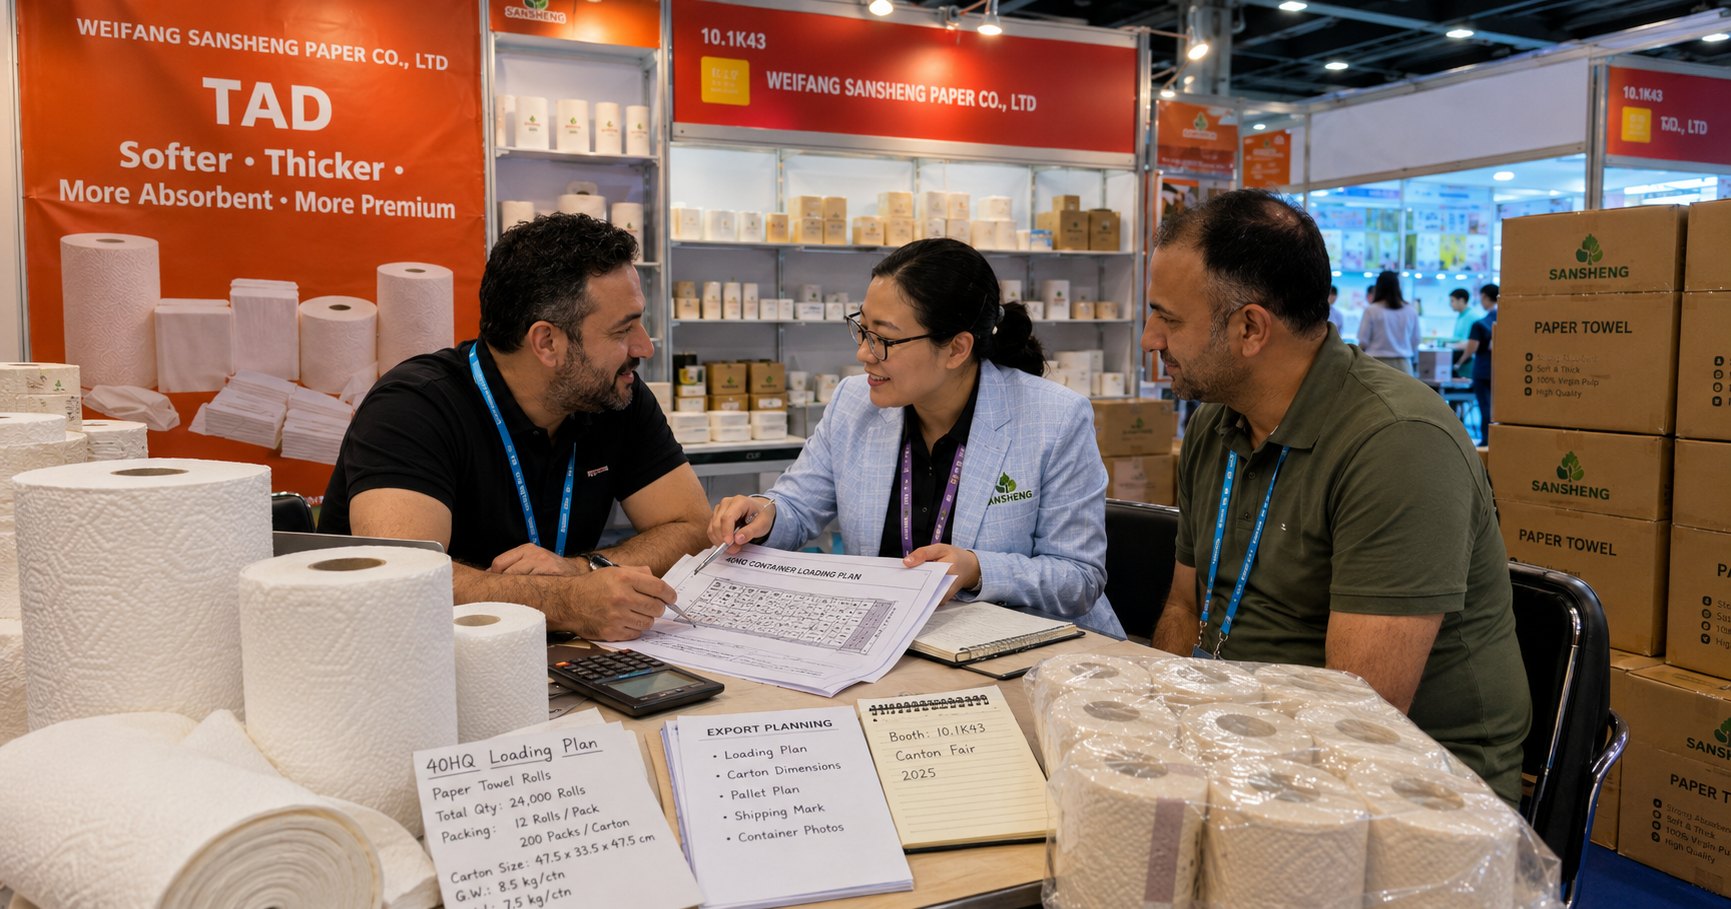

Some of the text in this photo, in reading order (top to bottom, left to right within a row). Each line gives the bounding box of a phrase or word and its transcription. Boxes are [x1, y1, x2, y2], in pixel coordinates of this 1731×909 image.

[506, 7, 565, 22] SANSHENG
[77, 18, 449, 71] WEIFANG SANSHENG PAPER CO., LTD
[701, 27, 766, 49] 10.1K43
[766, 70, 1037, 112] WEIFANG SANSHENG PAPER CO., LTD
[1623, 85, 1663, 102] 10.1K43
[202, 77, 332, 131] TAD
[1688, 119, 1708, 135] LTD
[119, 141, 384, 181] Softer Thicker
[59, 179, 456, 219] More Absorbent More Premium
[1549, 266, 1629, 280] SANSHENG
[1534, 321, 1632, 334] PAPER TOWEL
[988, 490, 1033, 506] ANSHENG
[1531, 480, 1610, 500] SANSHENG
[1519, 529, 1617, 556] PAPER TOWEL
[749, 560, 796, 574] CONTAINER
[797, 568, 837, 578] LOADING
[837, 571, 862, 581] PLAN
[707, 719, 833, 737] EXPORT PLANNING
[889, 722, 986, 743] Booth: 10.1K43
[426, 737, 598, 774] 40HQ Loading Plan
[724, 744, 808, 761] Loading Plan
[895, 744, 976, 762] Canton Fair
[727, 761, 841, 780] Carton Dimensions
[902, 768, 937, 781] 2025
[433, 770, 551, 800] Paper Towel Rolls
[730, 784, 800, 800] Pallet Plan
[1670, 773, 1717, 800] PAPER
[435, 785, 586, 823] Total Qty: 24,000 Rolls
[734, 803, 826, 823] Shipping Mark
[442, 825, 497, 844] Packing:
[515, 817, 528, 829] 12
[533, 813, 561, 825] Rolls
[572, 804, 600, 817] Pack
[520, 834, 542, 848] 200
[547, 827, 580, 843] Packs
[592, 818, 630, 834] Carton
[738, 822, 845, 843] Container Photos
[451, 866, 493, 884] Carton
[498, 860, 529, 875] Size:
[535, 851, 562, 866] 47.5
[575, 844, 599, 858] 33.5
[611, 836, 636, 849] 47.5
[639, 834, 656, 844] cm
[456, 870, 566, 902] G.W.: 8.5 kg/ctn
[503, 887, 572, 909] 7.5 kg/ctn
